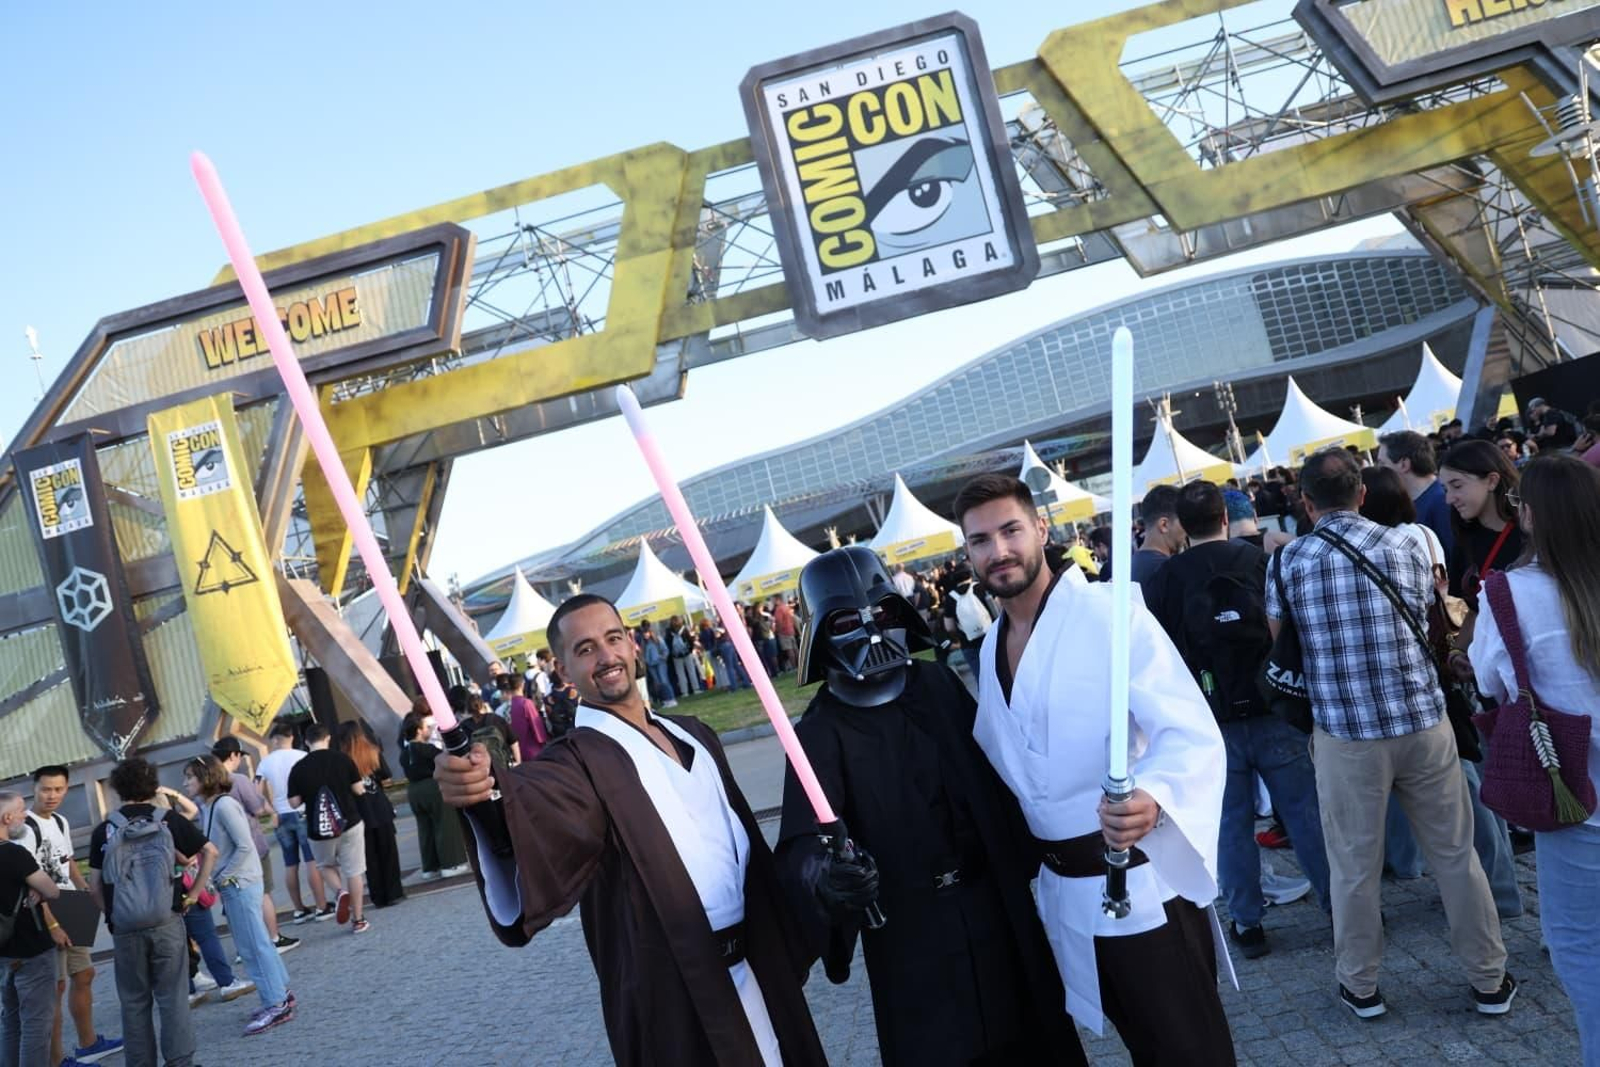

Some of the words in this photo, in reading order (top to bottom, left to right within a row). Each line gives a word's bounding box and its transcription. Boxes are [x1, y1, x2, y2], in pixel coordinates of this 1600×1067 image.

[777, 82, 831, 108] SAN
[857, 49, 949, 86] DIEGO
[848, 70, 962, 146] CON
[787, 102, 875, 269] COMIC
[825, 241, 998, 302] MÁLAGA
[198, 286, 361, 369] WELOME
[172, 438, 197, 489] COMIC
[189, 430, 220, 452] CON
[35, 476, 60, 526] COMIC
[51, 467, 80, 489] CON
